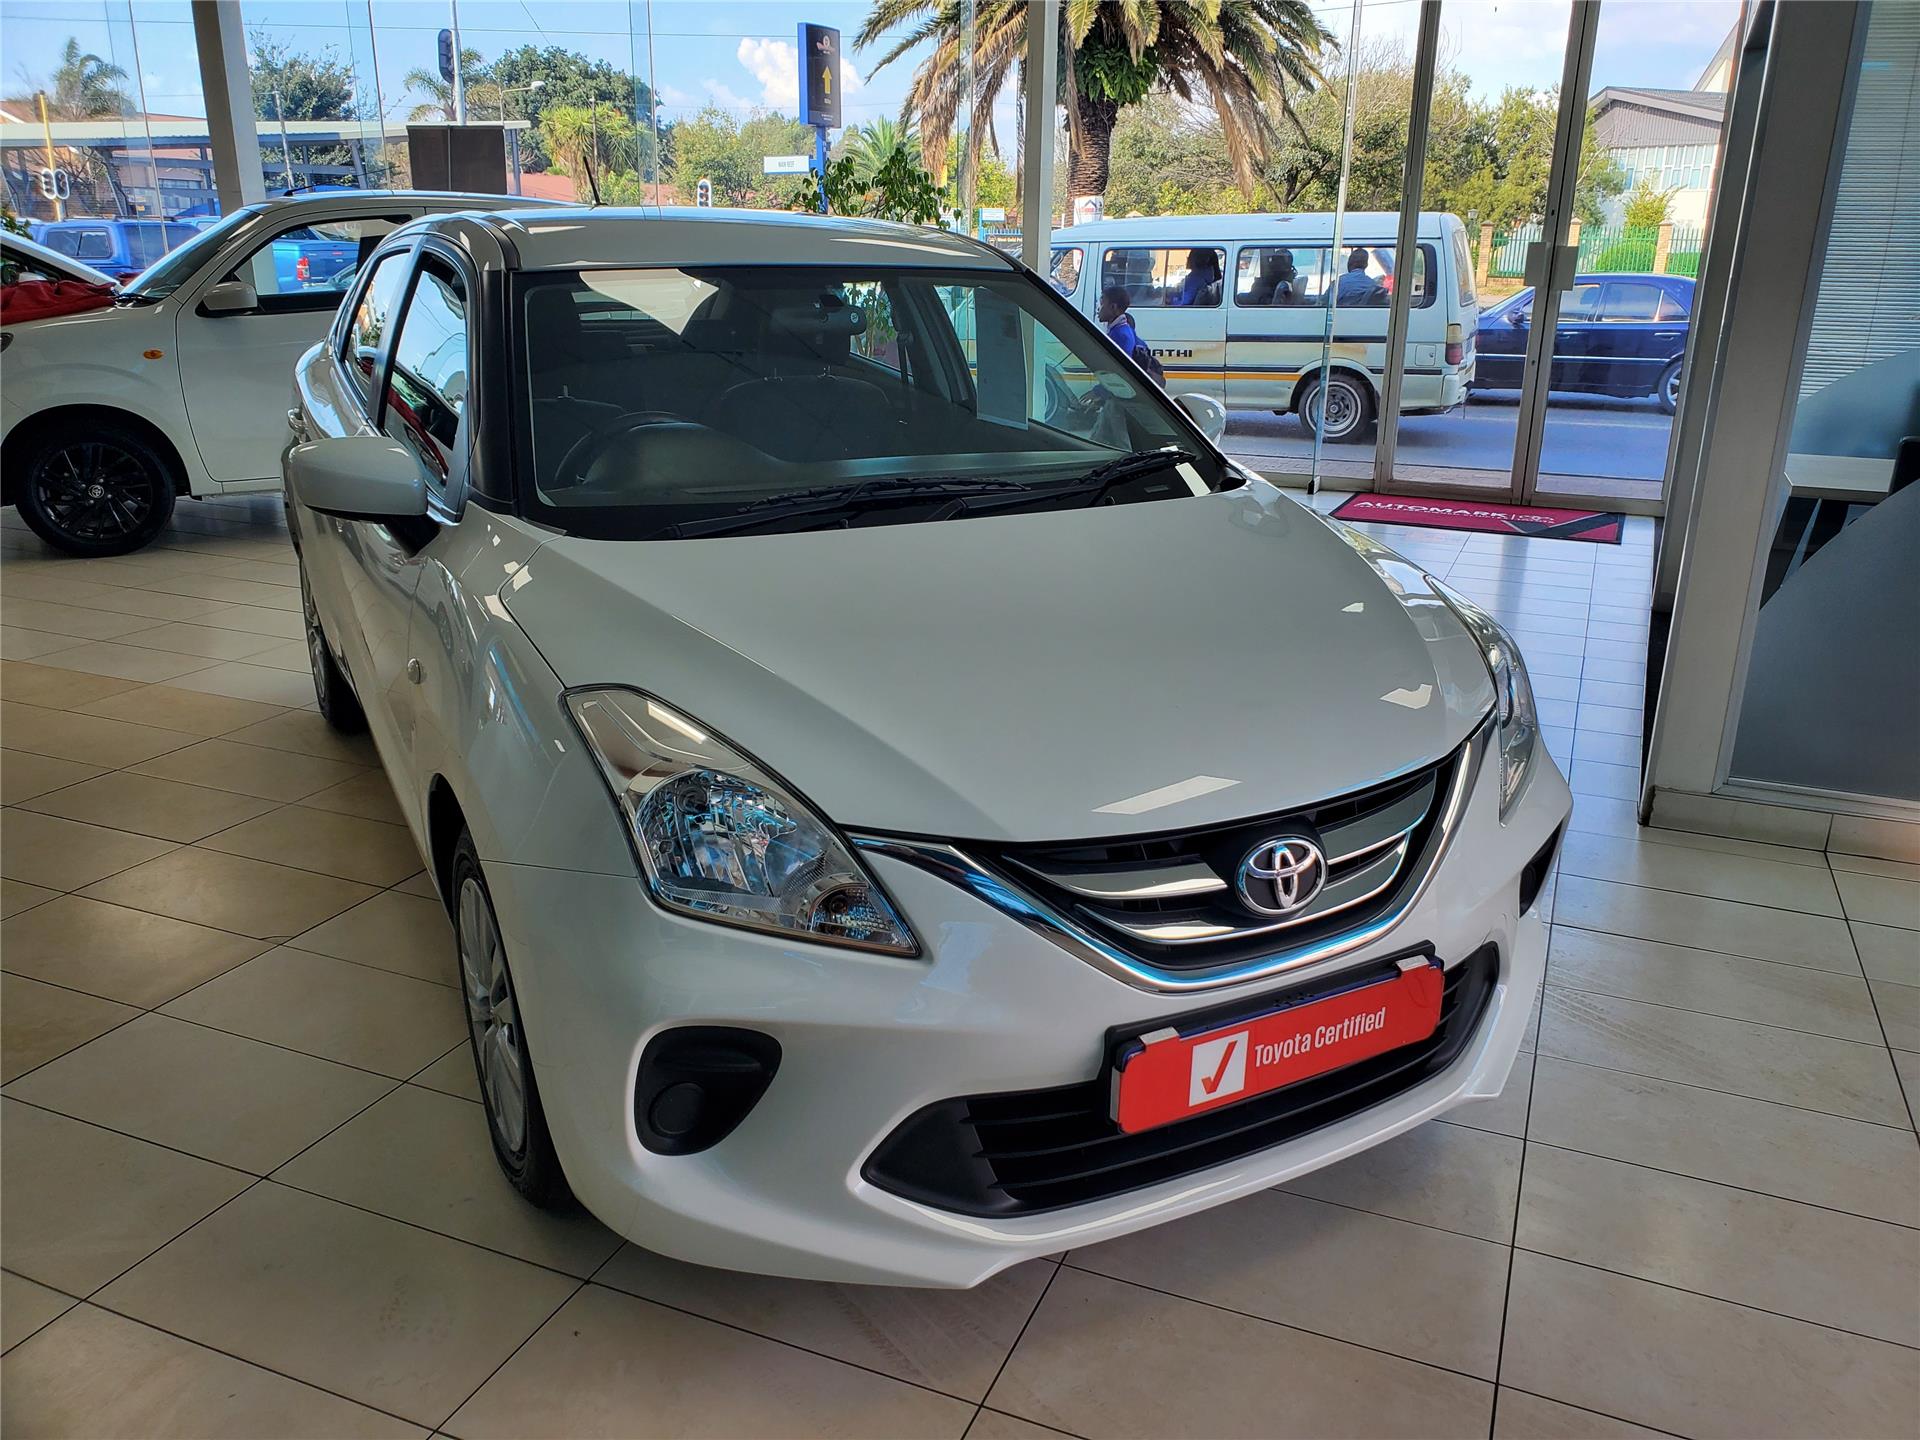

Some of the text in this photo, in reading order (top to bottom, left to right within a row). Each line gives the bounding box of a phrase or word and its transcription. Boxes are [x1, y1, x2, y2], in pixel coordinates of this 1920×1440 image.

[1149, 348, 1192, 358] ATHI
[1353, 501, 1508, 519] AUTOMARK
[1255, 1006, 1386, 1068] Toyota Certified
